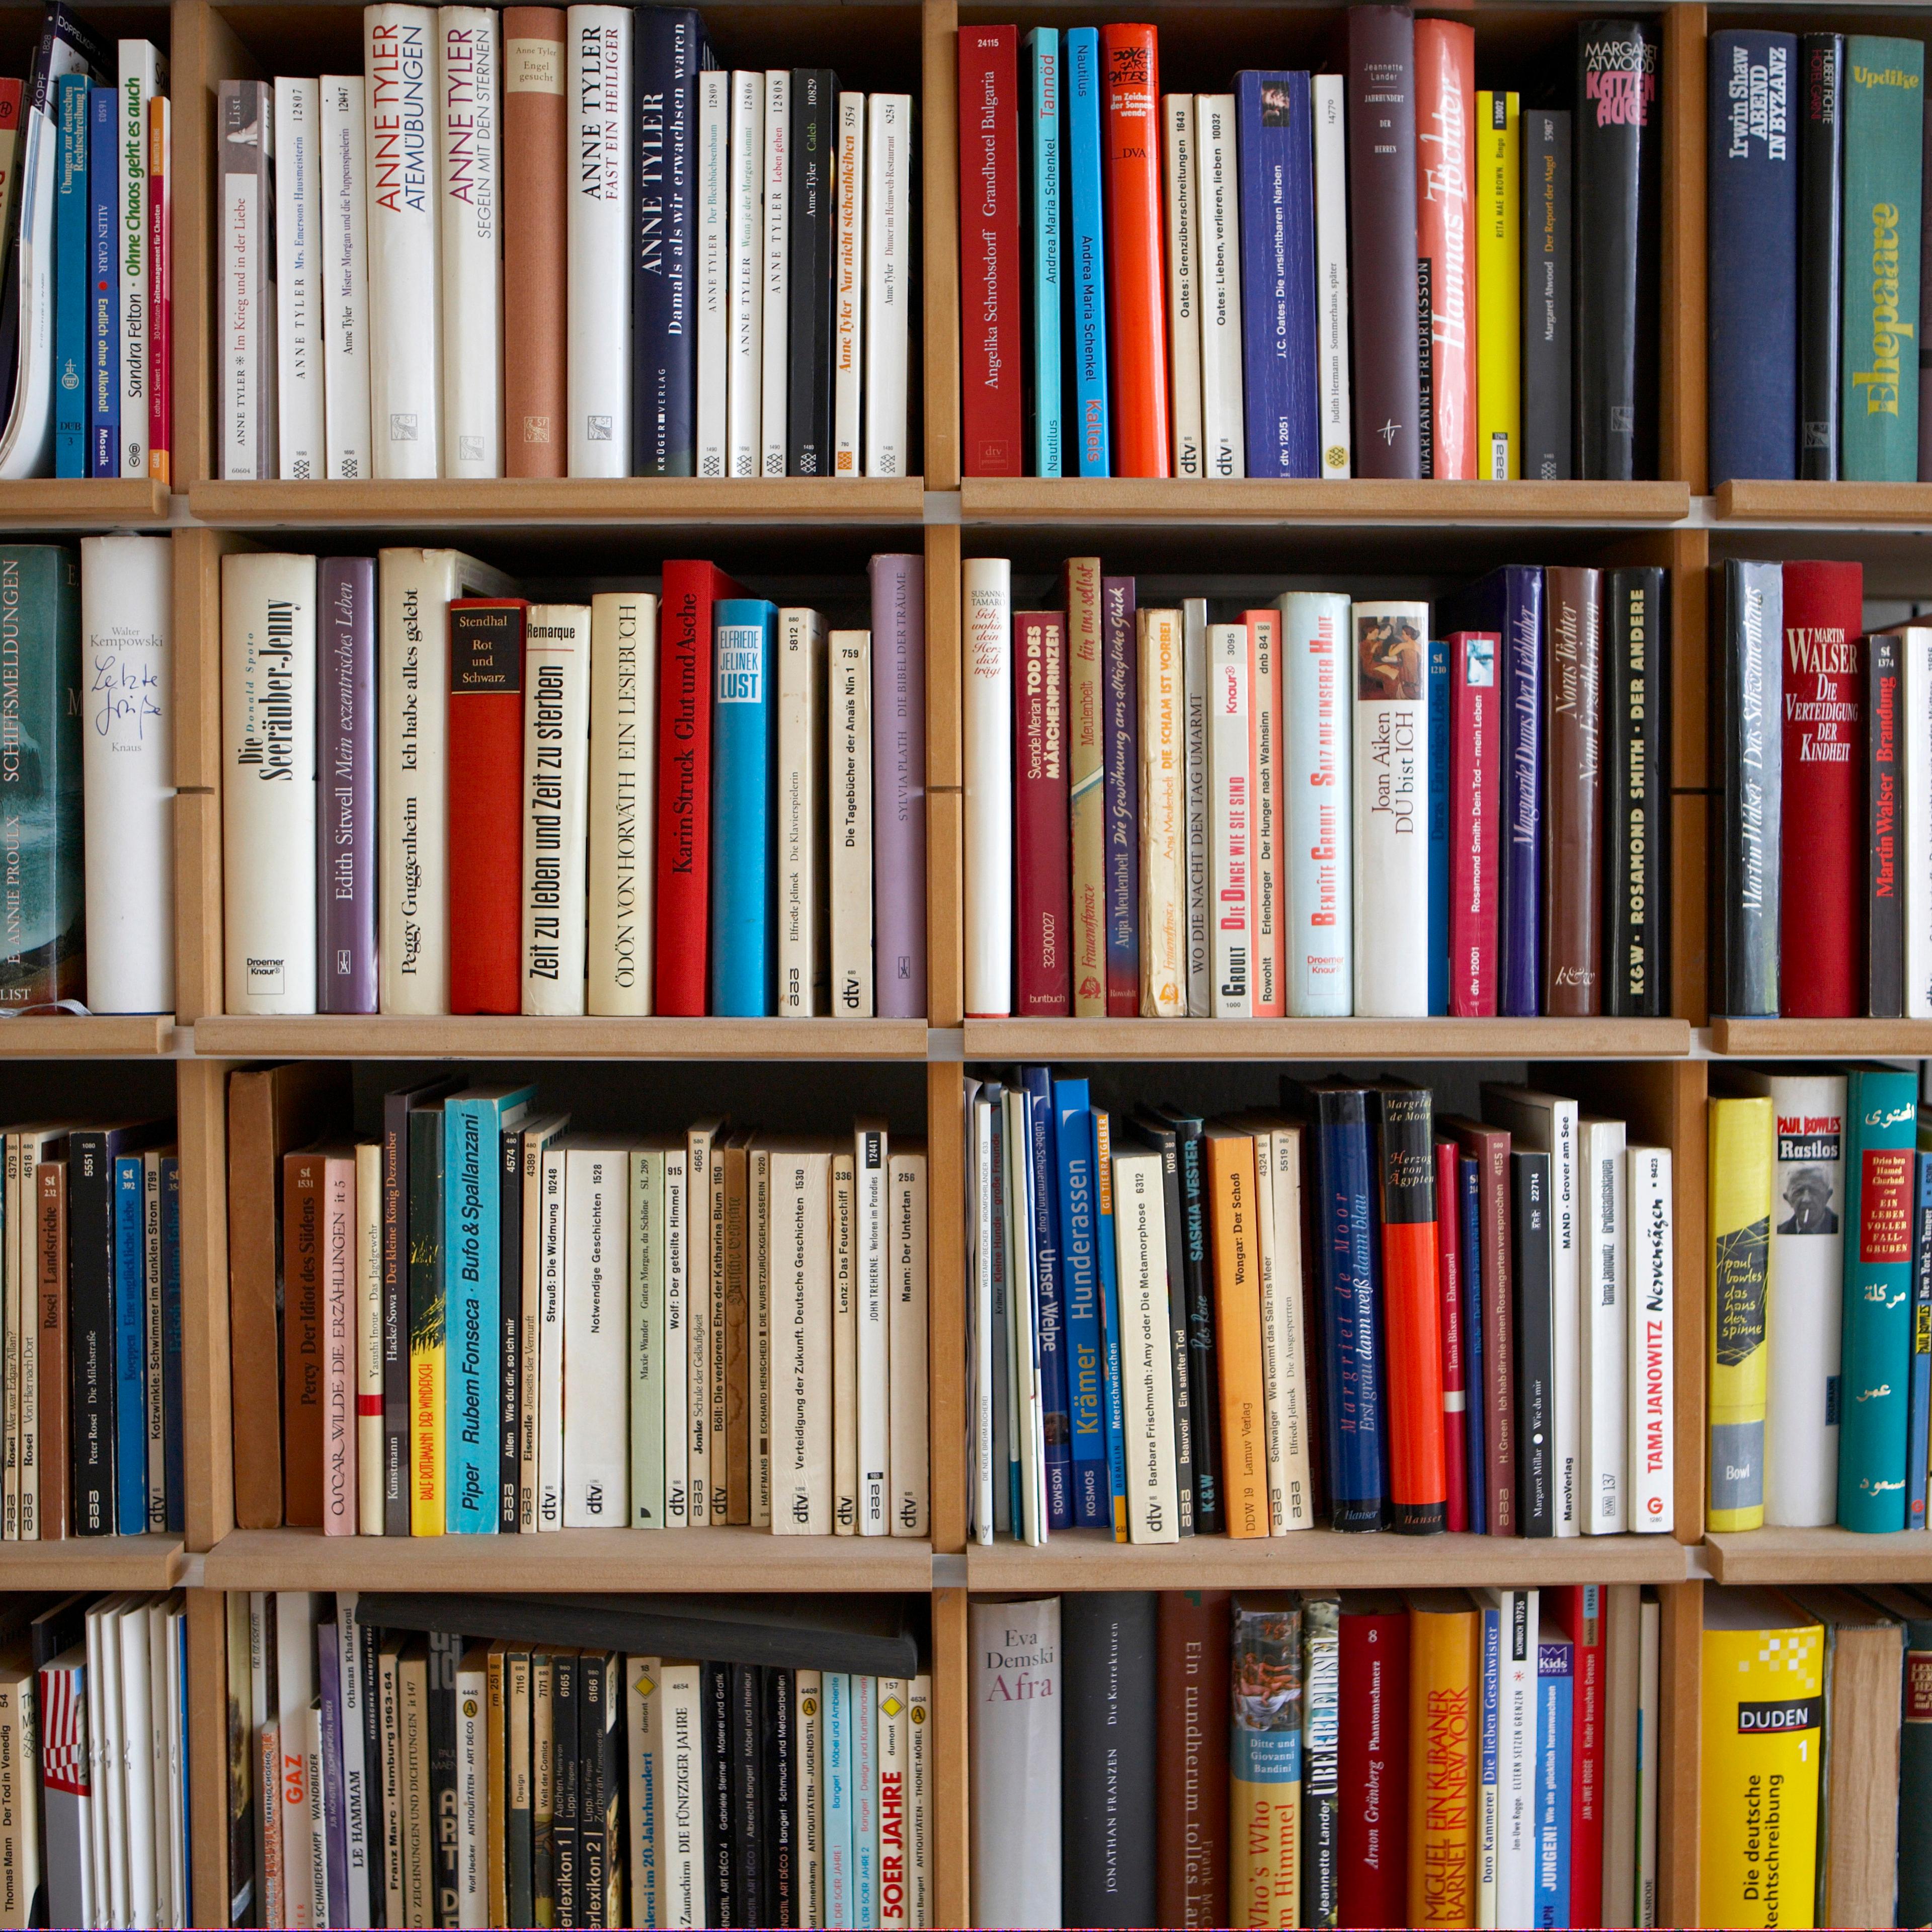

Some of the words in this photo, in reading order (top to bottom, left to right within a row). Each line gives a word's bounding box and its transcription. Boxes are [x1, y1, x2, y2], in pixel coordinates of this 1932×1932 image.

[516, 46, 535, 55] Anne
[537, 47, 557, 56] Tyler
[978, 39, 999, 47] 24115
[1585, 41, 1658, 59] MARGARET
[519, 72, 553, 83] gesucht
[524, 60, 548, 71] Engel
[1371, 73, 1397, 81] Lander
[1587, 55, 1654, 74] ATWOOD
[1729, 46, 1748, 100] Shaw
[1854, 65, 1919, 90] Updike
[125, 77, 140, 117] auch
[808, 78, 817, 105] 10829
[981, 71, 997, 129] Bulgaria
[1040, 55, 1055, 118] Tannöd
[1363, 94, 1404, 104] JAHRHUNDERT
[1768, 47, 1787, 132] BYZANZ
[229, 99, 240, 125] List
[292, 89, 302, 121] 12807
[1328, 99, 1336, 124] 14770
[1750, 63, 1769, 141] ABEND
[128, 121, 140, 137] es
[402, 26, 425, 212] ATEMÜBUNGEN
[845, 106, 855, 126] 5154
[1379, 119, 1392, 128] DER
[642, 93, 664, 187] TYLER
[807, 123, 817, 151] Caleb
[1729, 101, 1748, 159] Irwin
[125, 140, 145, 178] geht
[1122, 147, 1148, 159] DVA
[1374, 144, 1398, 154] HERREN
[1768, 133, 1787, 161] IN
[981, 135, 996, 216] Grandhotel
[125, 182, 140, 230] Chaos
[642, 197, 663, 275] ANNE
[125, 234, 140, 276] Ohne
[127, 294, 142, 338] Felton
[127, 343, 142, 398] Sandra
[1279, 417, 1289, 446] 12051
[100, 429, 109, 466] Mosaik
[1280, 449, 1289, 466] dtv
[112, 627, 140, 635] Walter
[459, 615, 507, 627] Stendhal
[527, 623, 575, 640] Remarque
[90, 634, 164, 650] Kempowski
[473, 639, 492, 650] Rot
[720, 630, 759, 649] ELFRIEDE
[789, 627, 798, 651] 5812
[1227, 633, 1236, 655] 3095
[1814, 628, 1844, 643] MARTIN
[472, 656, 493, 666] und
[720, 652, 758, 671] JELINEK
[842, 649, 859, 658] 759
[1433, 654, 1442, 663] st
[1878, 659, 1894, 668] 1374
[462, 672, 506, 683] Schwarz
[1429, 665, 1448, 675] 1210
[257, 599, 300, 780] Seeräuber-Jenny
[720, 673, 758, 698] LUST
[1045, 623, 1062, 780] MÄRCHENPRINZEN
[1371, 712, 1390, 767] Aiken
[1395, 711, 1413, 753] ICH
[1817, 722, 1837, 741] DER
[112, 742, 141, 752] Knaus
[1395, 757, 1414, 794] bist
[1630, 739, 1645, 799] SMITH
[1372, 773, 1394, 814] Joan
[1395, 799, 1413, 834] DU
[401, 797, 421, 916] Guggenheim
[1630, 808, 1645, 925] ROSAMOND
[1262, 870, 1272, 935] Erlenberger
[401, 920, 421, 974] Peggy
[1042, 912, 1055, 968] 323/00027
[247, 957, 285, 967] Droemer
[1471, 947, 1480, 976] 12001
[1262, 957, 1272, 1002] Rowohlt
[1471, 979, 1479, 995] dtv
[1, 988, 31, 1000] LIST
[1029, 994, 1065, 1003] buntbuch
[869, 1140, 877, 1162] 12441
[1780, 1140, 1839, 1159] Rastlos
[84, 1153, 95, 1178] 5551
[593, 1164, 602, 1184] 1528
[668, 1167, 682, 1175] 915
[834, 1171, 852, 1181] 336
[1166, 1152, 1177, 1175] 1016
[1494, 1152, 1504, 1177] 4155
[43, 1189, 58, 1198] 232
[45, 1176, 55, 1185] st
[548, 1168, 557, 1195] 10248
[1531, 1172, 1540, 1203] 22714
[1870, 1209, 1904, 1220] LEBEN
[1879, 1198, 1897, 1208] EIN
[547, 1203, 559, 1256] Widmung
[838, 1190, 848, 1254] Feuerschiff
[1234, 1212, 1243, 1234] Der
[1069, 1159, 1094, 1320] Hunderassen
[547, 1259, 556, 1277] Die
[839, 1257, 848, 1279] Das
[1235, 1237, 1246, 1285] Wongar:
[546, 1280, 556, 1322] Strauß:
[839, 1282, 848, 1313] Lenz:
[1647, 1321, 1662, 1415] JANOWITZ
[1075, 1343, 1100, 1434] Krämer
[150, 1367, 160, 1439] Kotzwinkle:
[88, 1414, 97, 1439] Rosei
[89, 1441, 98, 1464] Peter
[1647, 1421, 1662, 1473] TAMA
[387, 1435, 399, 1499] Kunstmann
[1724, 1464, 1750, 1481] Bowl
[462, 1462, 482, 1511] Piper
[1085, 1469, 1096, 1518] KOSMOS
[1564, 1458, 1574, 1521] MaroVerlag
[1604, 1474, 1616, 1490] 137
[343, 1607, 357, 1662] Khadraoui
[1005, 1630, 1039, 1648] Eva
[986, 1646, 1053, 1669] Demski
[1107, 1623, 1118, 1700] Korrekturen
[1540, 1657, 1568, 1669] Kids
[343, 1667, 357, 1709] Othman
[986, 1672, 1052, 1702] Afra
[1107, 1704, 1117, 1725] Die
[1740, 1708, 1808, 1728] DUDEN
[676, 1708, 691, 1749] JAHRE
[1799, 1740, 1807, 1761] 1
[285, 1753, 304, 1805] GAZ
[1253, 1762, 1292, 1774] Bandini
[311, 1753, 321, 1821] WANDBILDER
[516, 1774, 525, 1802] Design
[676, 1754, 689, 1827] FÜNFZIGER
[349, 1771, 362, 1842] HAMMAM
[882, 1771, 904, 1851] JAHRE
[1743, 1775, 1760, 1862] deutsche
[1483, 1793, 1494, 1851] Kammerer
[4, 1837, 13, 1867] Mann
[353, 1848, 364, 1867] LE
[1541, 1825, 1559, 1892] JUNGEN!
[1483, 1857, 1493, 1883] Doro
[5, 1869, 14, 1912] Thomas
[1743, 1869, 1759, 1900] Die
